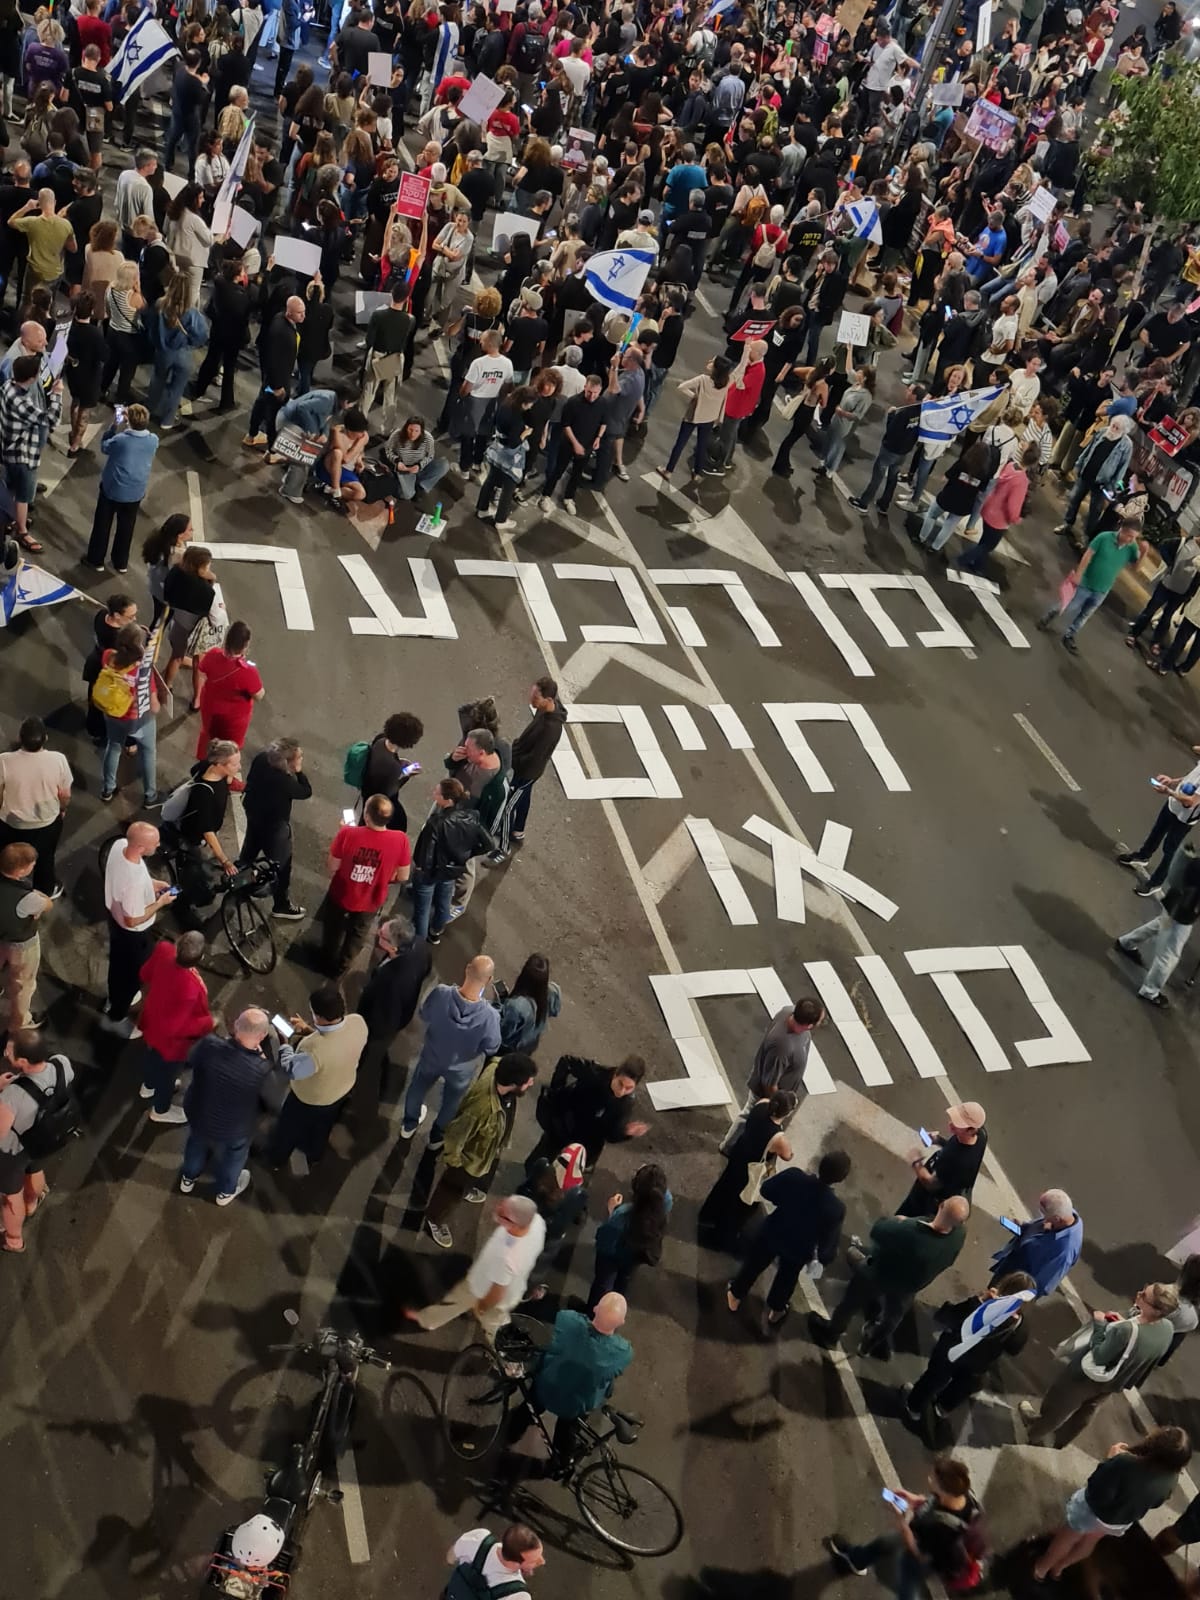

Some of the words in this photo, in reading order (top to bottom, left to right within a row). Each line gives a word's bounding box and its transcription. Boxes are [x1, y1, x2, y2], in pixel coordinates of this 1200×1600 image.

[786, 568, 1031, 677] זמן
[532, 702, 911, 800] חיים
[350, 872, 375, 885] אשם
[354, 864, 376, 874] אתה
[684, 815, 899, 925] או
[646, 945, 1092, 1111] מוות
